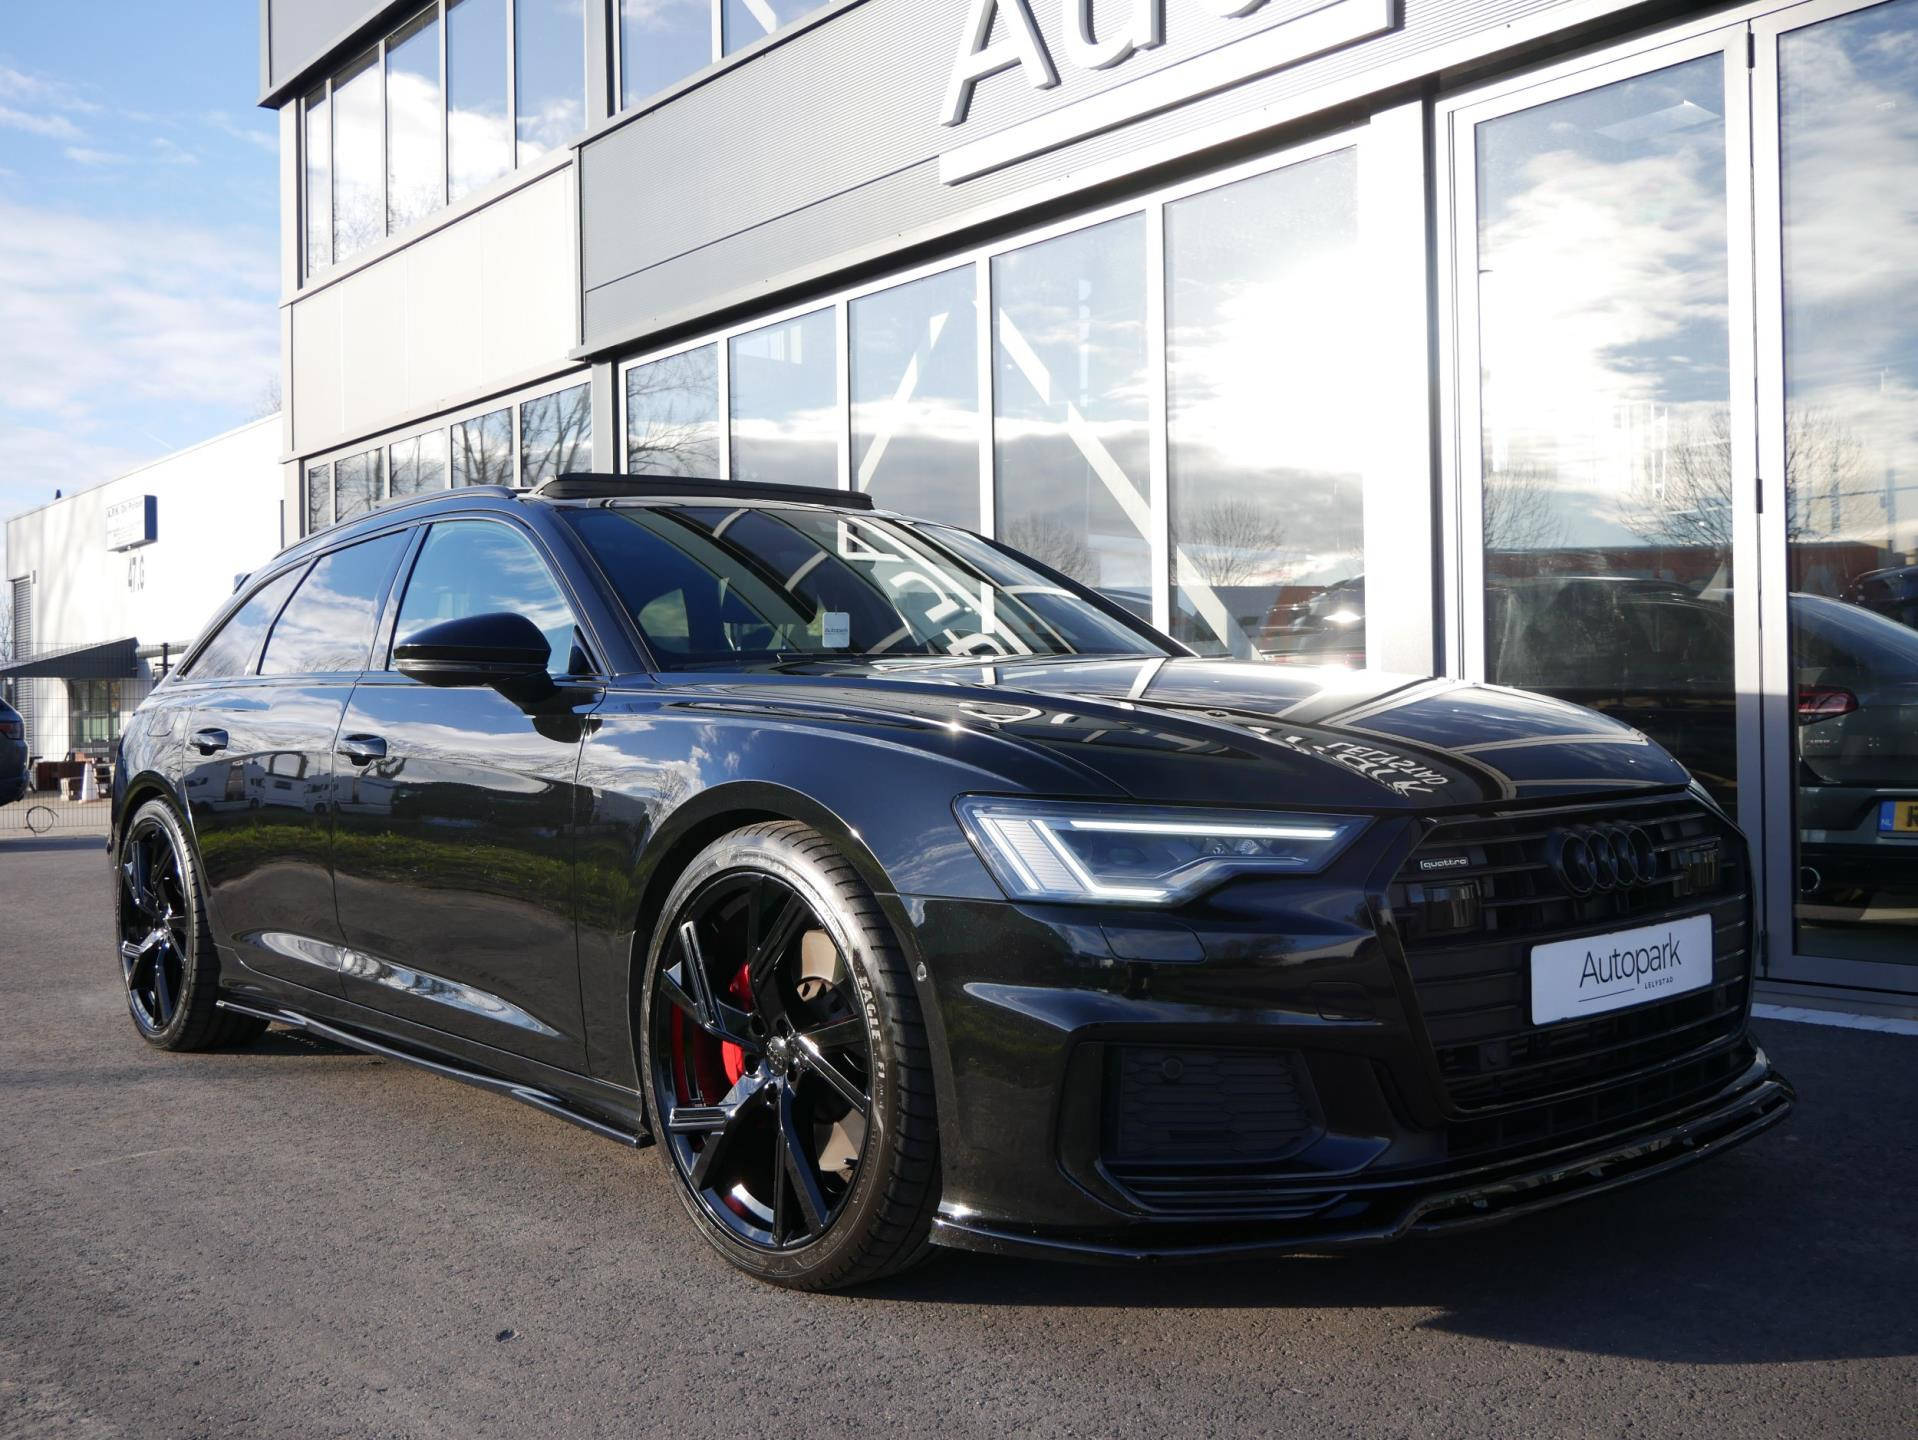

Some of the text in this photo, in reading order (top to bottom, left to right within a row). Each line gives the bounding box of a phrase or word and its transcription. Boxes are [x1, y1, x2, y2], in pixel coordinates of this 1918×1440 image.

[1422, 858, 1468, 870] quattro
[1579, 932, 1682, 989] Autopark
[1644, 976, 1674, 990] LELYSTAD
[858, 976, 882, 1042] EAGLE
